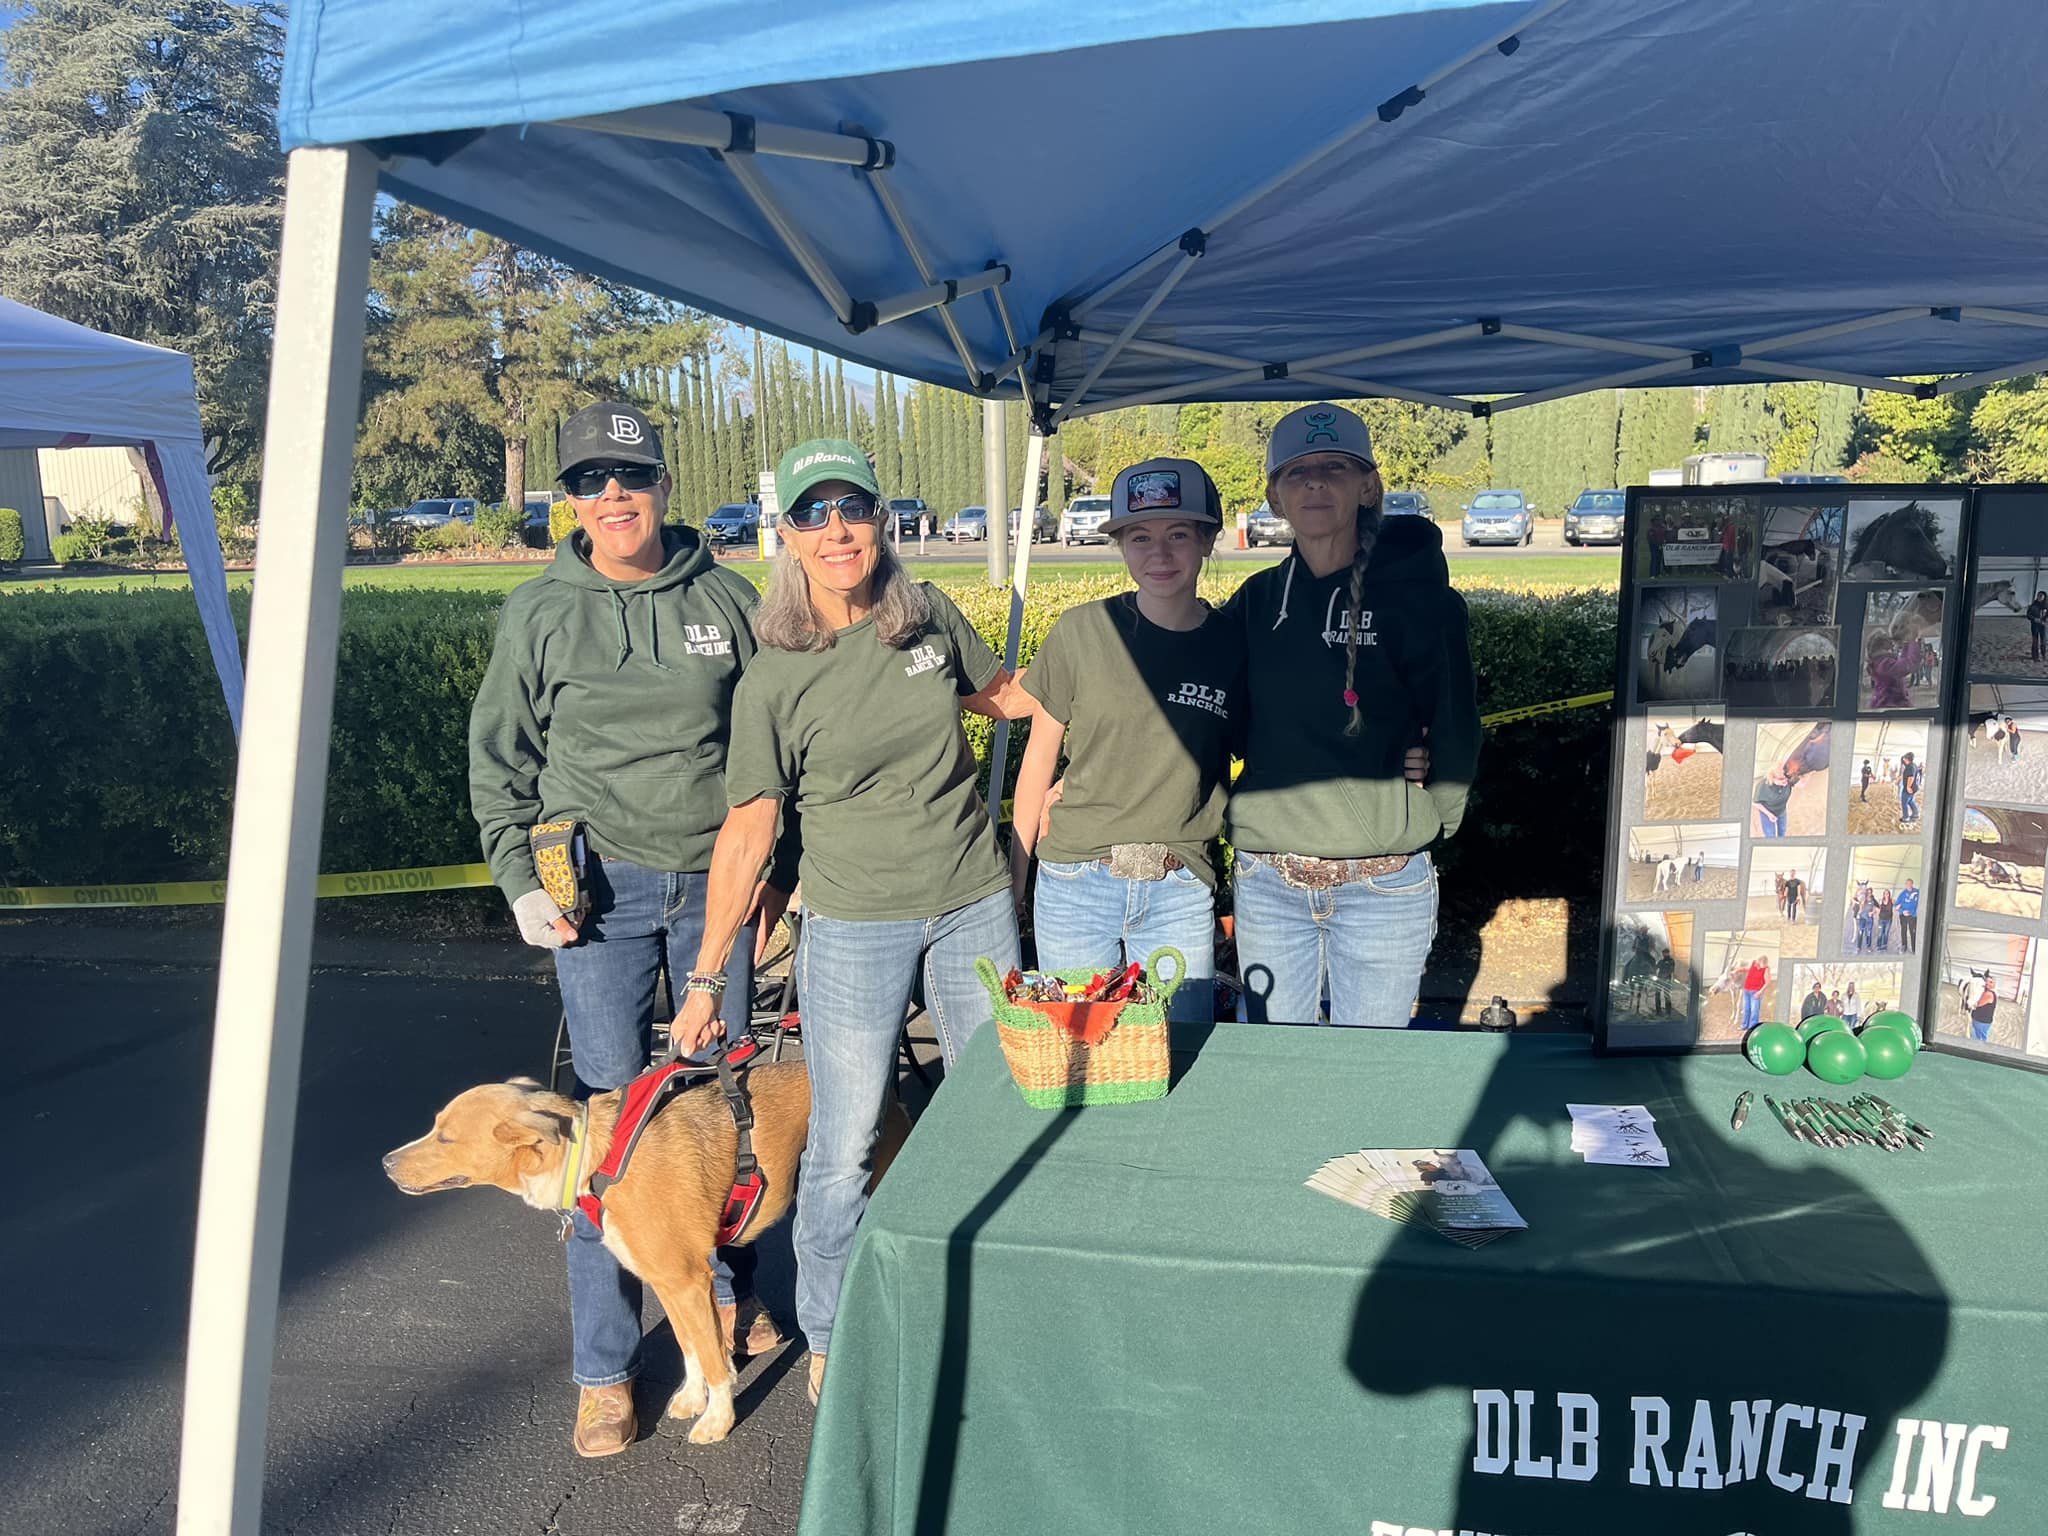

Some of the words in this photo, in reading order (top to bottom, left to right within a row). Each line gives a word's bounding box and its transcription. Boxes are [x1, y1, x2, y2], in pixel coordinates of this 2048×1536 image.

[792, 456, 814, 475] DLB
[814, 452, 856, 465] Ranch
[1339, 610, 1373, 629] DB
[683, 624, 721, 642] DLB
[1329, 630, 1362, 645] RANH
[1363, 632, 1377, 645] INC
[713, 641, 731, 655] INC
[910, 644, 936, 664] DLB
[904, 659, 935, 677] RANCH
[1167, 693, 1214, 712] RANCH
[1179, 682, 1227, 706] DLB
[1472, 1388, 1600, 1482] DLB
[1628, 1396, 1867, 1505] RANCH
[1881, 1418, 2010, 1517] INC
